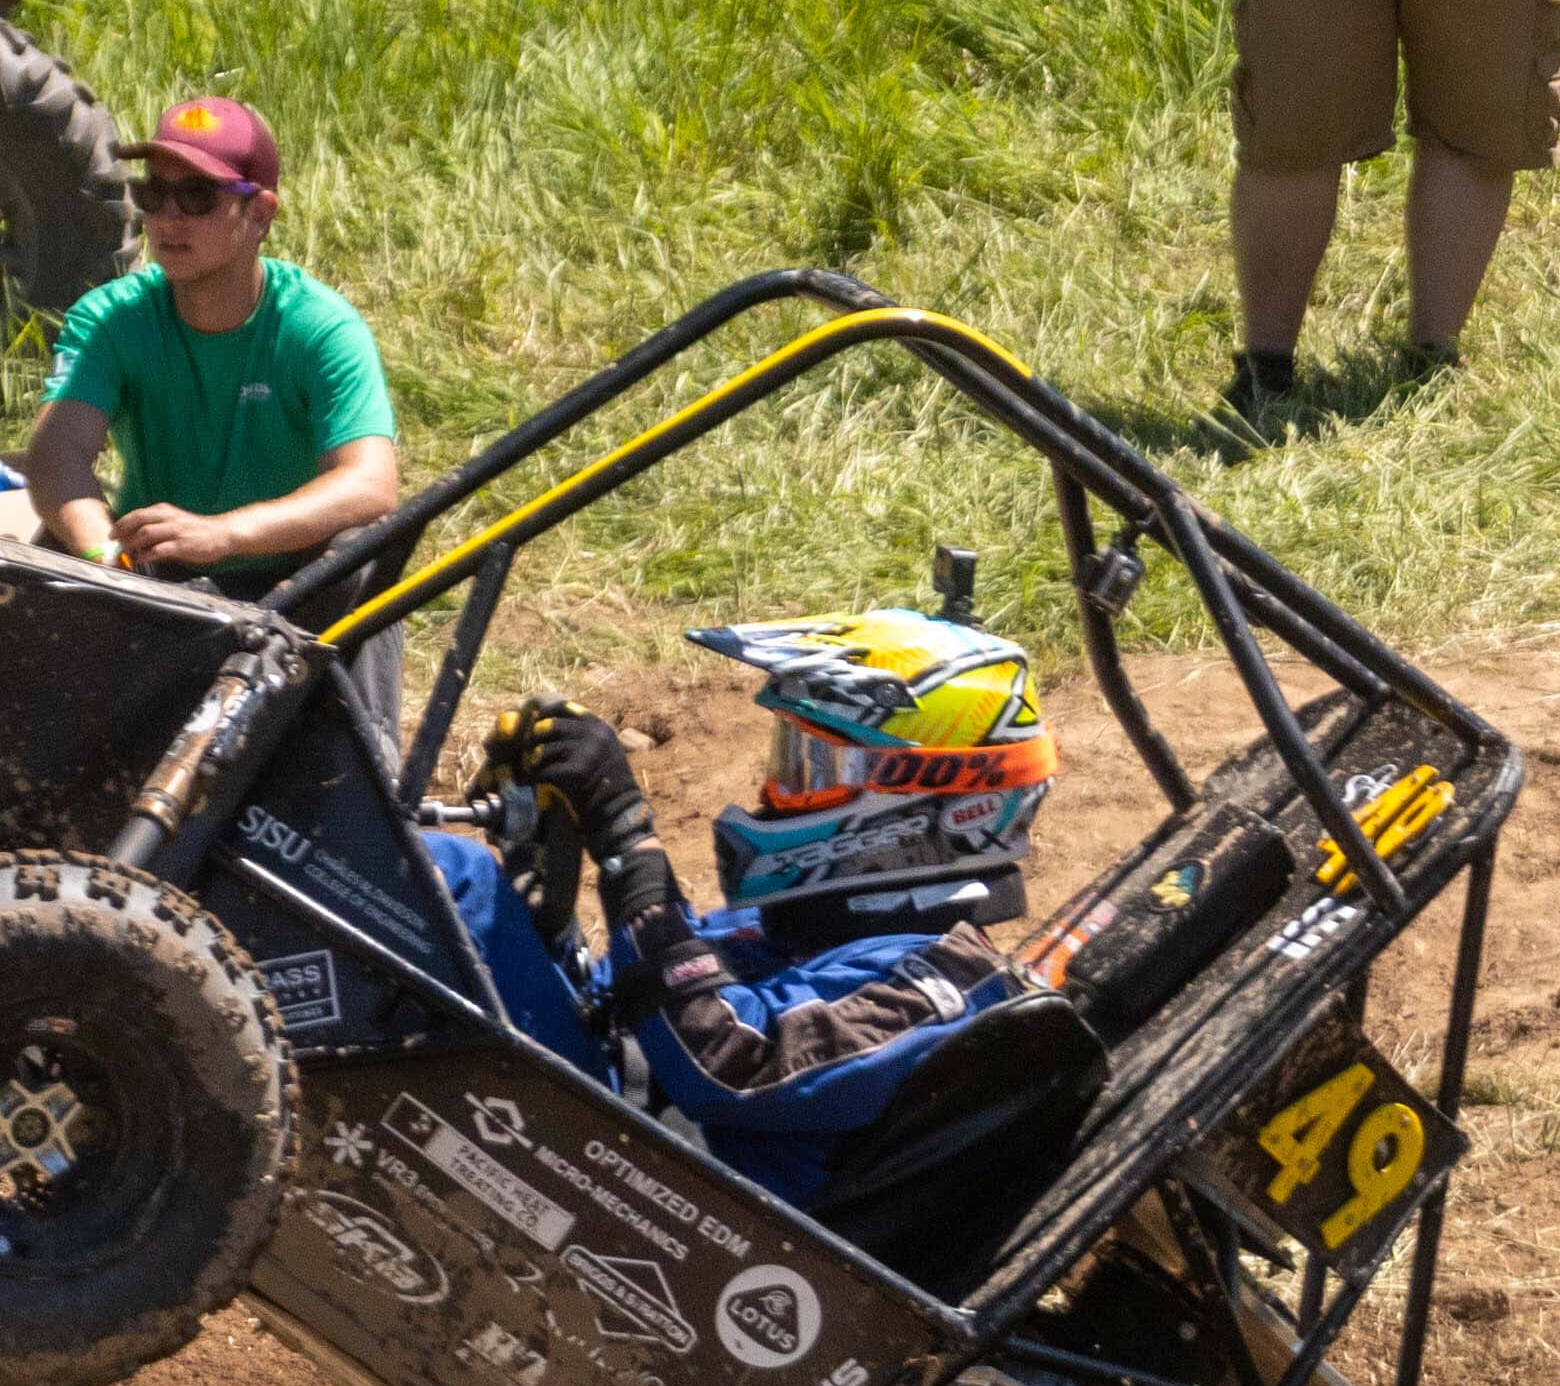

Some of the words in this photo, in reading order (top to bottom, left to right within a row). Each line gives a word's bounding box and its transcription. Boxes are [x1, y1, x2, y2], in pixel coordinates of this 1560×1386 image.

[237, 805, 311, 864] SJSU
[950, 798, 997, 826] BELL
[584, 1140, 700, 1223] OPTIMIZED
[697, 1213, 752, 1259] EDM
[1258, 1063, 1425, 1250] 49
[534, 1145, 690, 1262] MICRO-MECHANICS
[729, 1296, 796, 1351] LOTUS
